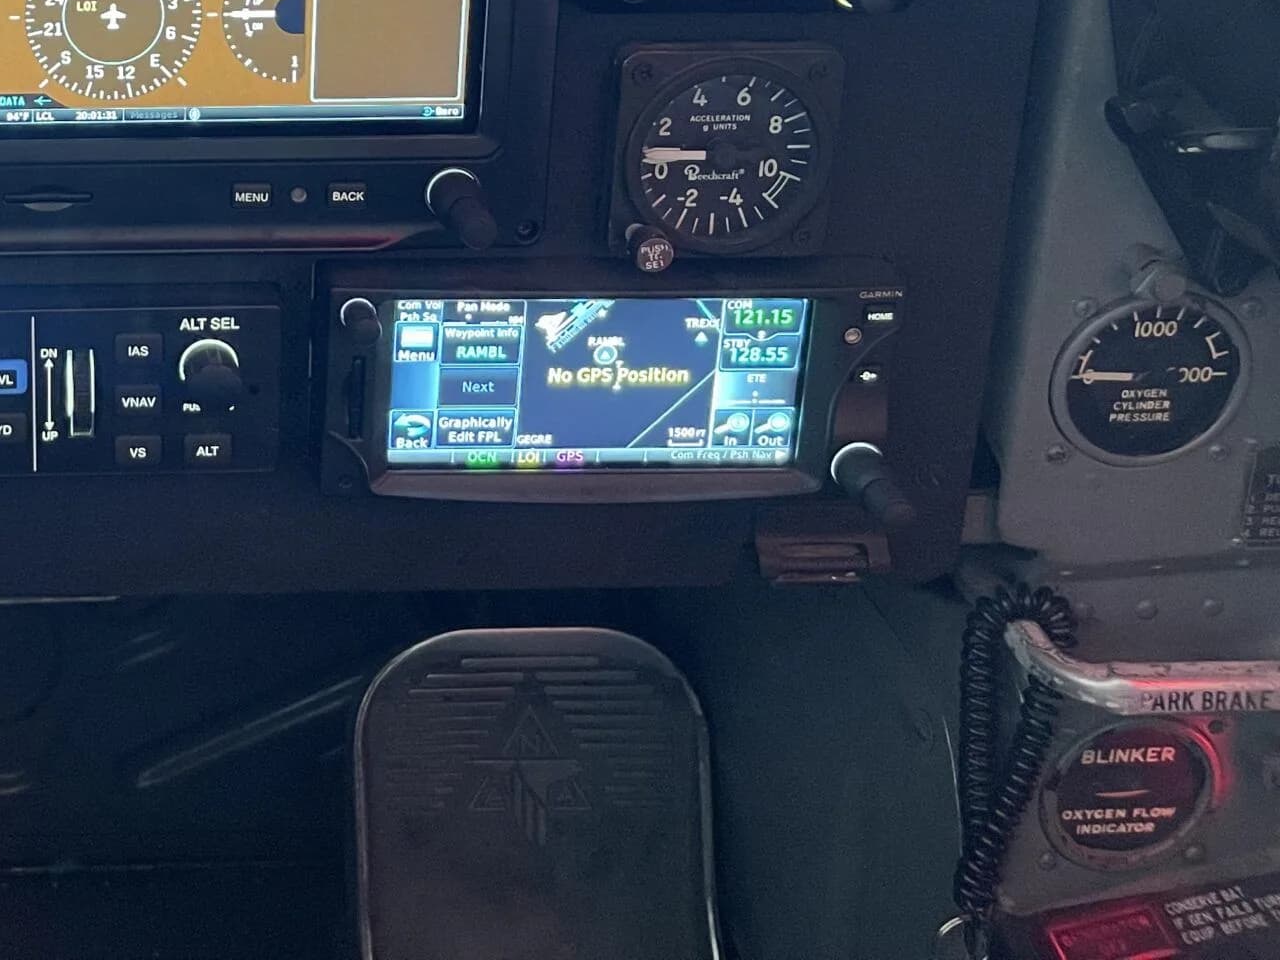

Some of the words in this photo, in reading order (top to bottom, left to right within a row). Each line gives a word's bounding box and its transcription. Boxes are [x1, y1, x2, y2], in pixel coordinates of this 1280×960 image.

[44, 23, 62, 36] 21
[86, 66, 104, 80] 15
[117, 66, 135, 80] 12
[0, 95, 24, 107] DATA
[693, 89, 707, 106] 4
[738, 87, 751, 105] 6
[770, 116, 782, 133] 8
[759, 159, 777, 177] 10
[235, 191, 268, 203] MENU
[332, 190, 364, 202] BACK
[677, 189, 697, 206] -2
[720, 188, 743, 205] -4
[734, 310, 792, 325] 121.15
[180, 318, 207, 331] ALT
[211, 317, 240, 330] SEL
[1135, 322, 1176, 337] 1000
[445, 328, 495, 339] Waypoint
[498, 328, 518, 338] Info
[41, 348, 57, 359] DN
[128, 345, 149, 356] IAS
[398, 351, 434, 361] Menu
[456, 347, 506, 357] RAMBL
[730, 347, 788, 361] 128.55
[548, 369, 572, 383] No
[577, 368, 613, 382] GPS
[618, 367, 689, 383] Position
[462, 381, 494, 392] Next
[1121, 390, 1167, 398] OXYGEN
[122, 396, 156, 408] VNAV
[1113, 401, 1169, 410] CYLINDER
[439, 417, 512, 430] Graphically
[1110, 413, 1169, 422] PRESSURE
[42, 430, 57, 440] UP
[448, 432, 474, 442] Edit
[478, 432, 501, 442] FPL
[396, 439, 428, 448] Back
[129, 446, 146, 458] VS
[197, 447, 219, 456] ALT
[557, 451, 583, 461] GPS
[671, 450, 693, 459] Com
[697, 450, 720, 461] Freq
[1141, 693, 1194, 711] PARK
[1202, 691, 1270, 710] BRAKE
[1081, 747, 1175, 764] BLINKER
[1062, 809, 1126, 820] OXYGEN
[1133, 807, 1176, 818] FLOW
[1076, 823, 1155, 835] INDICATOR
